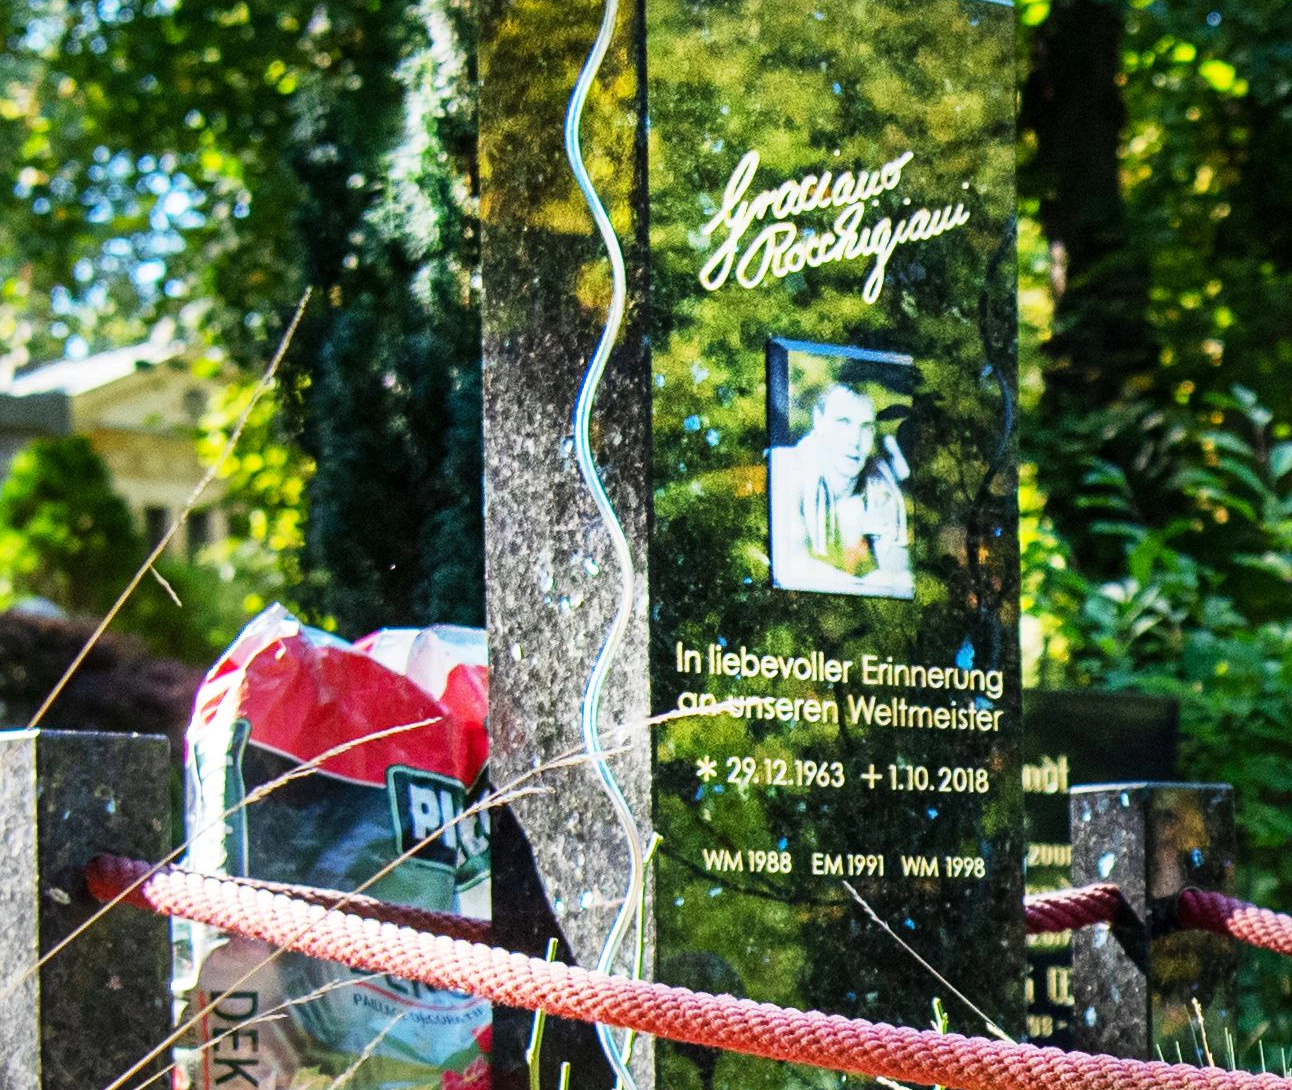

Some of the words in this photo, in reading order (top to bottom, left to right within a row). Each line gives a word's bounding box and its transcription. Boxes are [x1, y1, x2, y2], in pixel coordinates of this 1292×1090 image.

[700, 150, 914, 291] Graciano
[735, 180, 970, 304] Rocchigiani
[676, 641, 701, 675] In
[708, 644, 852, 684] liebevoller
[862, 654, 1004, 699] Erinnerung
[678, 690, 716, 714] an
[730, 694, 839, 724] unseren
[847, 694, 1004, 732] Weltmeister
[726, 756, 845, 788] 29.12.1963
[703, 848, 744, 873] WM
[748, 849, 792, 874] 1988
[811, 852, 843, 876] EM
[847, 853, 884, 877] 1991
[901, 855, 939, 878] WM
[945, 856, 986, 879] 1998
